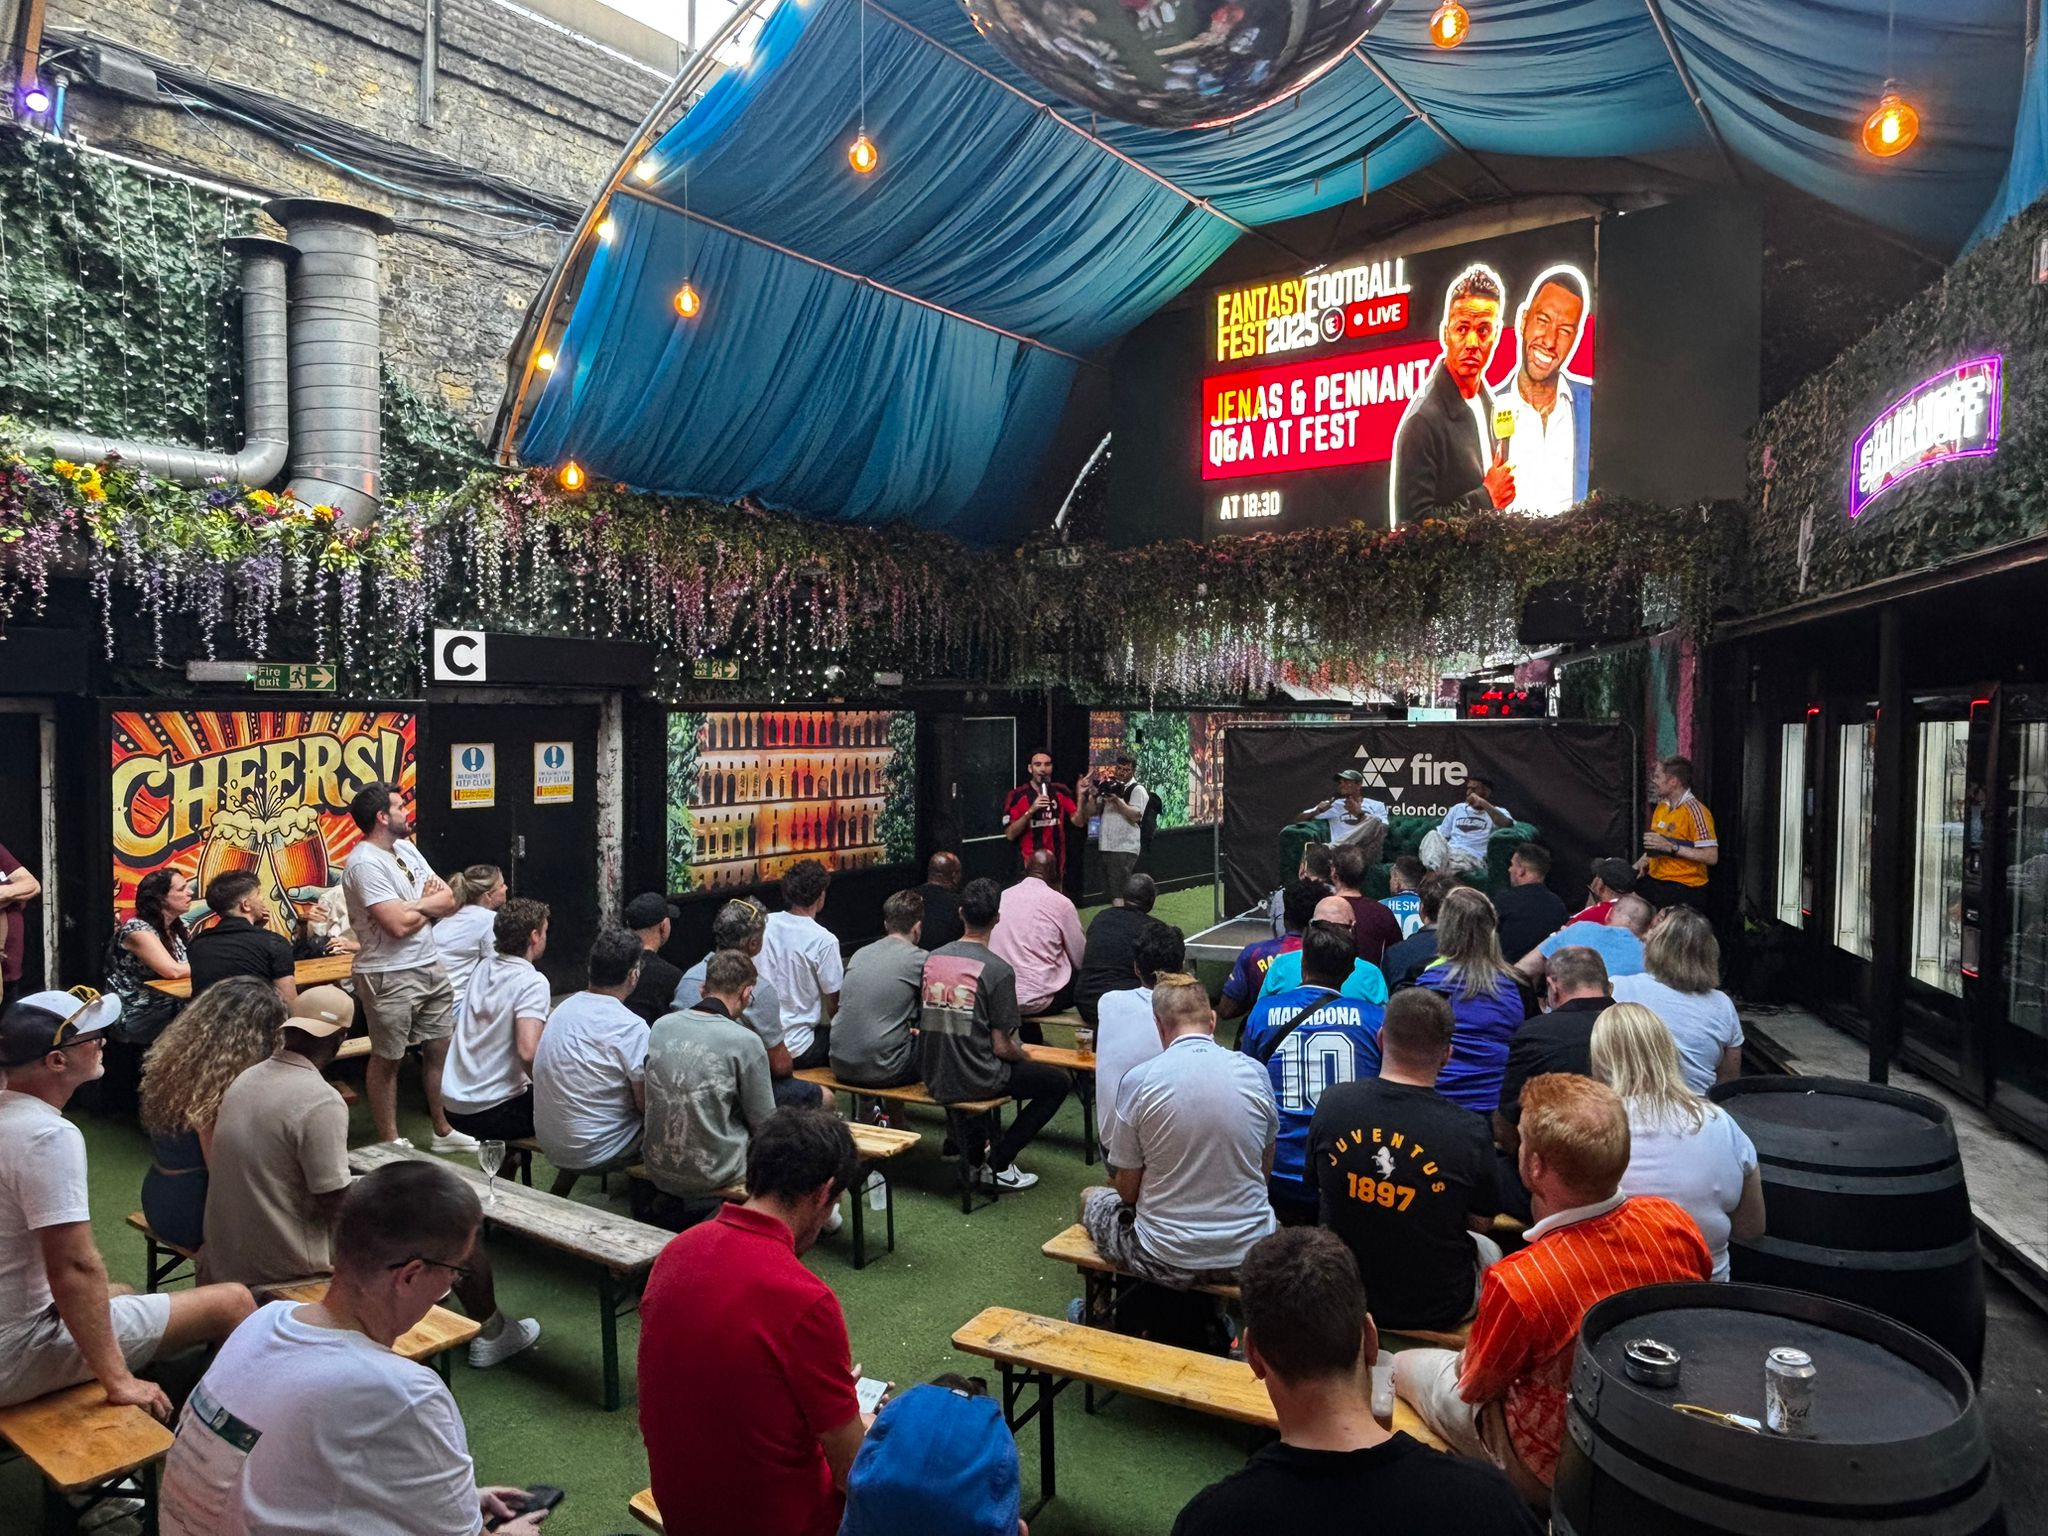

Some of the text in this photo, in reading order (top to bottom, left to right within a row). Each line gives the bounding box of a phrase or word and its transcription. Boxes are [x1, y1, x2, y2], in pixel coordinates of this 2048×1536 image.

[1367, 303, 1401, 326] LIVE
[1217, 309, 1320, 362] FEST2025
[1211, 359, 1430, 427] JENAS & PENNANT
[1209, 410, 1360, 467] Q&A AT FEST
[1220, 491, 1281, 520] AT 18:30
[258, 666, 281, 677] Fire
[442, 636, 480, 677] C
[258, 678, 281, 687] exit
[1410, 753, 1469, 786] fire
[113, 730, 401, 857] CHEERS!
[1276, 1031, 1356, 1112] 10
[1328, 1127, 1446, 1194] JUVENTUS
[1347, 1171, 1416, 1212] 1897
